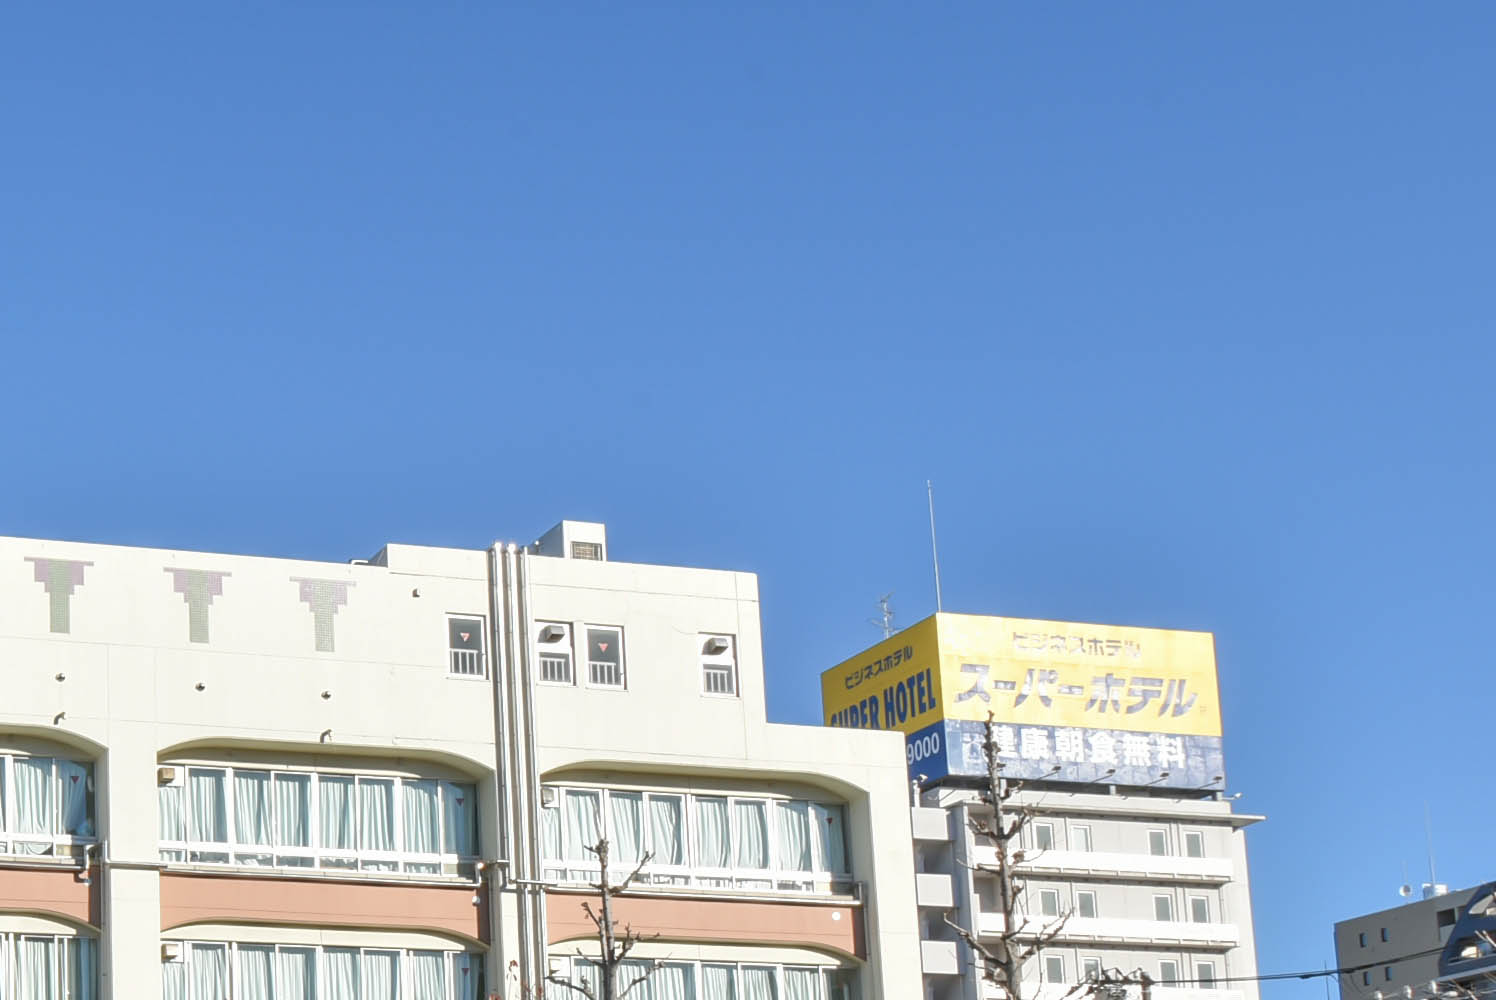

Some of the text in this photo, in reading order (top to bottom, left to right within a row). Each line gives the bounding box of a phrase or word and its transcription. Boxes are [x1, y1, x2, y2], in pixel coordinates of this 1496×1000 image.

[1012, 631, 1141, 659] ビジネスホテル
[845, 645, 913, 690] ビジネスホテル
[883, 667, 936, 729] HOTEL
[954, 663, 1199, 717] スーパーホテル
[906, 732, 940, 765] 9000
[988, 725, 1187, 769] 健康朝食無料
